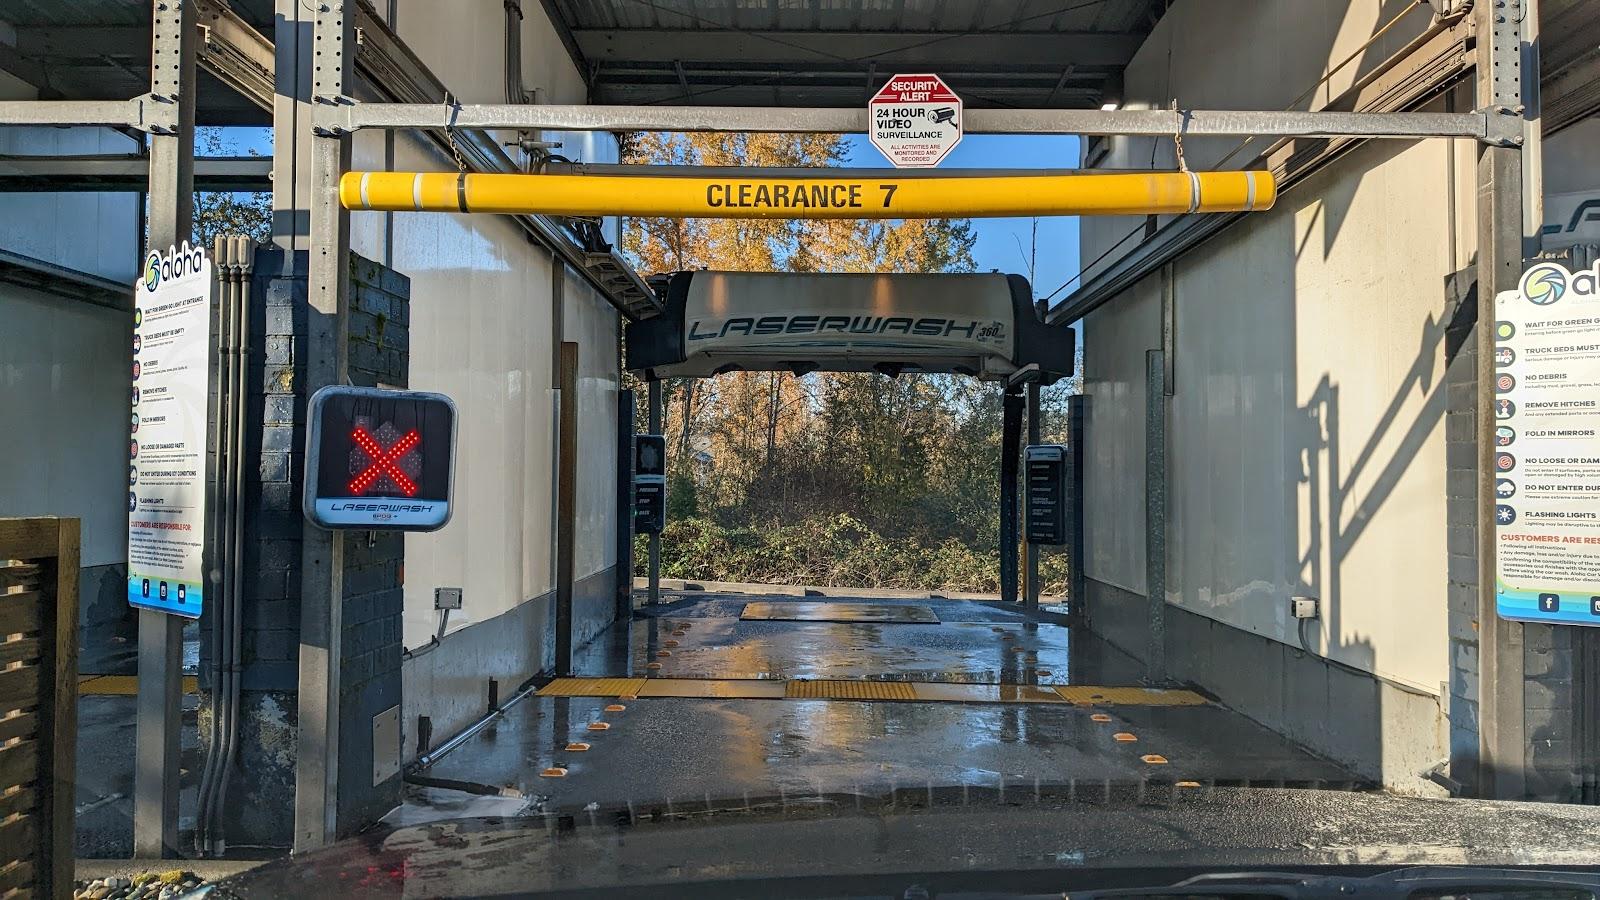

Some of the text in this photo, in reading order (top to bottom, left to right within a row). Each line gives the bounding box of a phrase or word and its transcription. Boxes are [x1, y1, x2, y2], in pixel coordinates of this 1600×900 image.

[891, 82, 939, 91] SECURITY
[900, 92, 931, 102] ALERT
[877, 108, 926, 118] 24 HOUR
[877, 120, 912, 129] VIDEO
[706, 184, 898, 208] CLEARANCE 7
[162, 244, 202, 282] aloha
[688, 316, 1000, 341] LASERWASH 360
[330, 503, 433, 512] LASERWASH
[1501, 534, 1560, 542] CUSTOMERS
